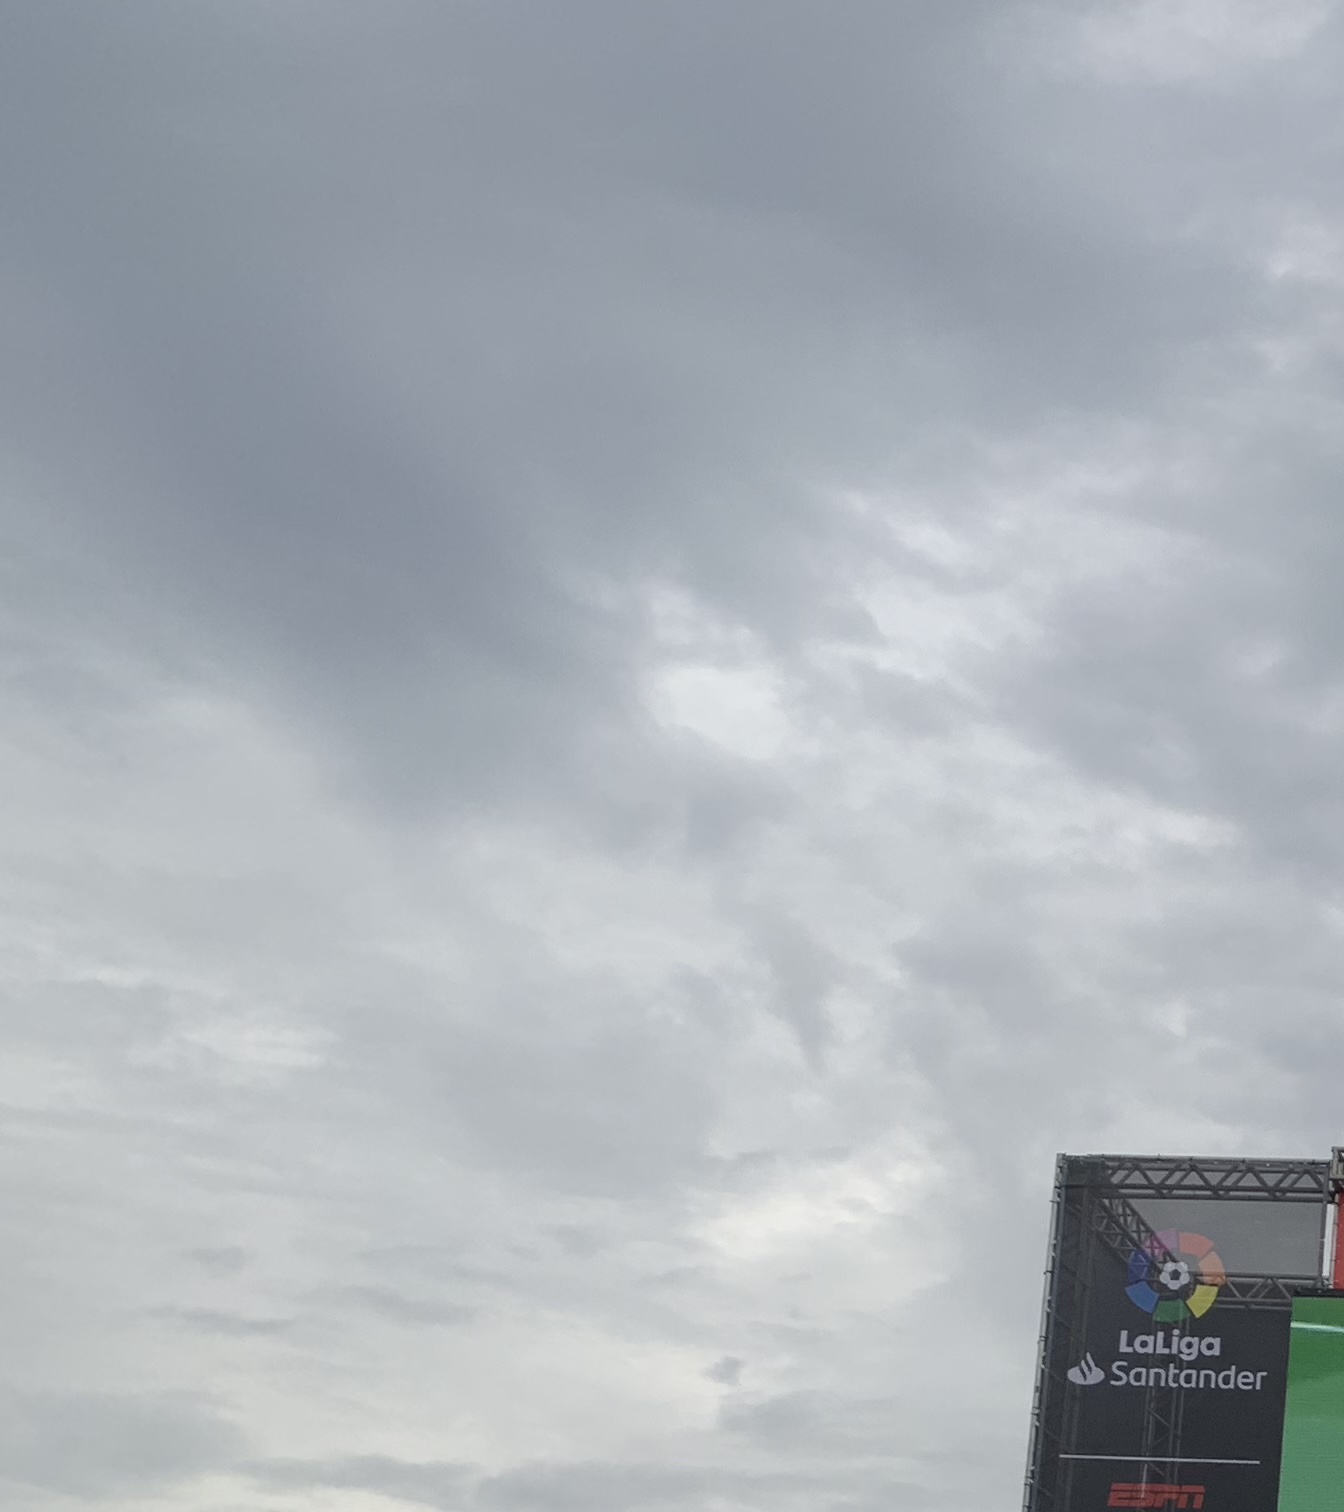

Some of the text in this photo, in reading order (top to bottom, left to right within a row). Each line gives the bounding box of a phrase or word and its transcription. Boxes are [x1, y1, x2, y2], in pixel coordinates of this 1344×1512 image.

[1118, 1329, 1222, 1361] LaLiga
[1109, 1360, 1268, 1390] Santander
[1107, 1483, 1206, 1509] ESPN
